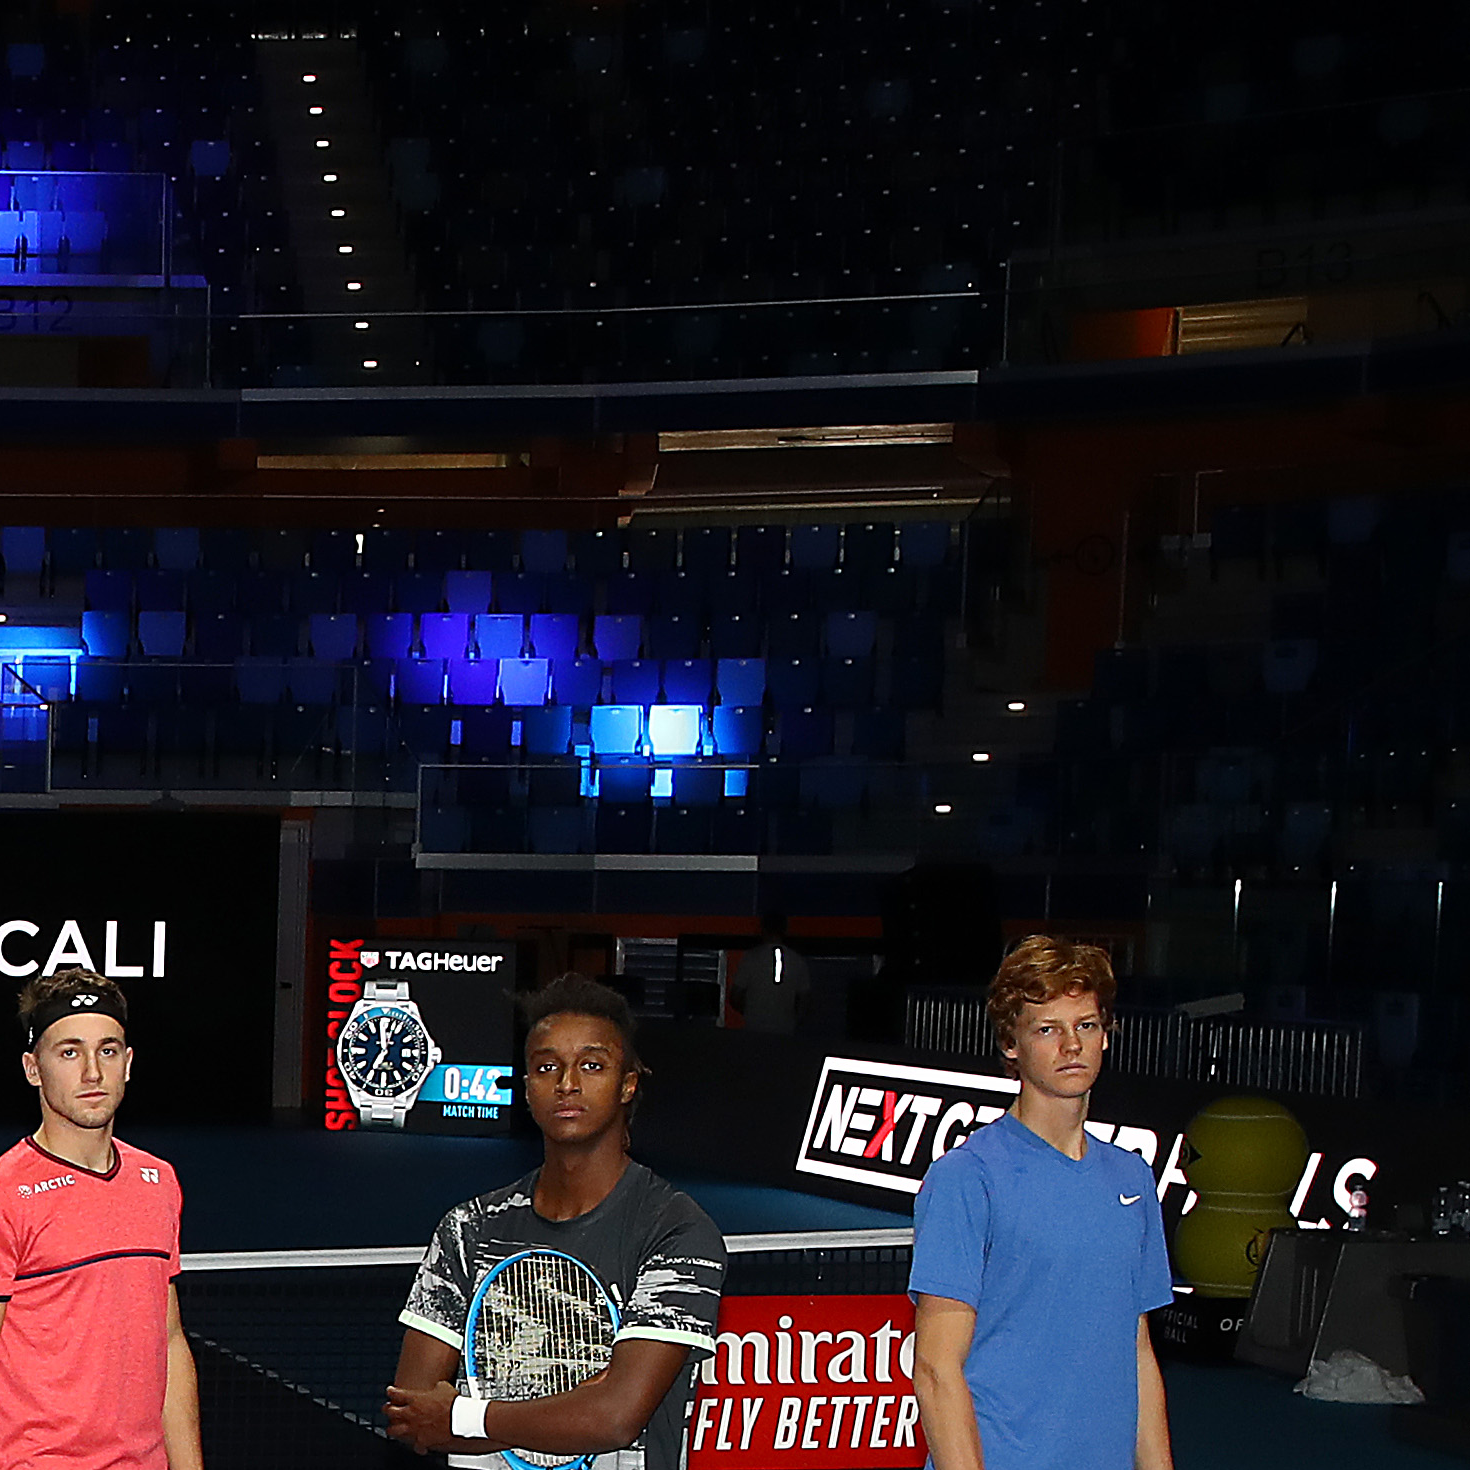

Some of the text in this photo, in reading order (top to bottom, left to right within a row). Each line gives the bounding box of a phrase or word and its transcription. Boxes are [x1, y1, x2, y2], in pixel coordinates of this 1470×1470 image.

[443, 1066, 504, 1101] 0:42
[442, 1104, 500, 1119] MATCH TIME
[812, 1083, 944, 1167] NEXT
[34, 1174, 76, 1194] ARCTIC
[692, 1395, 919, 1451] FLY BETTER
